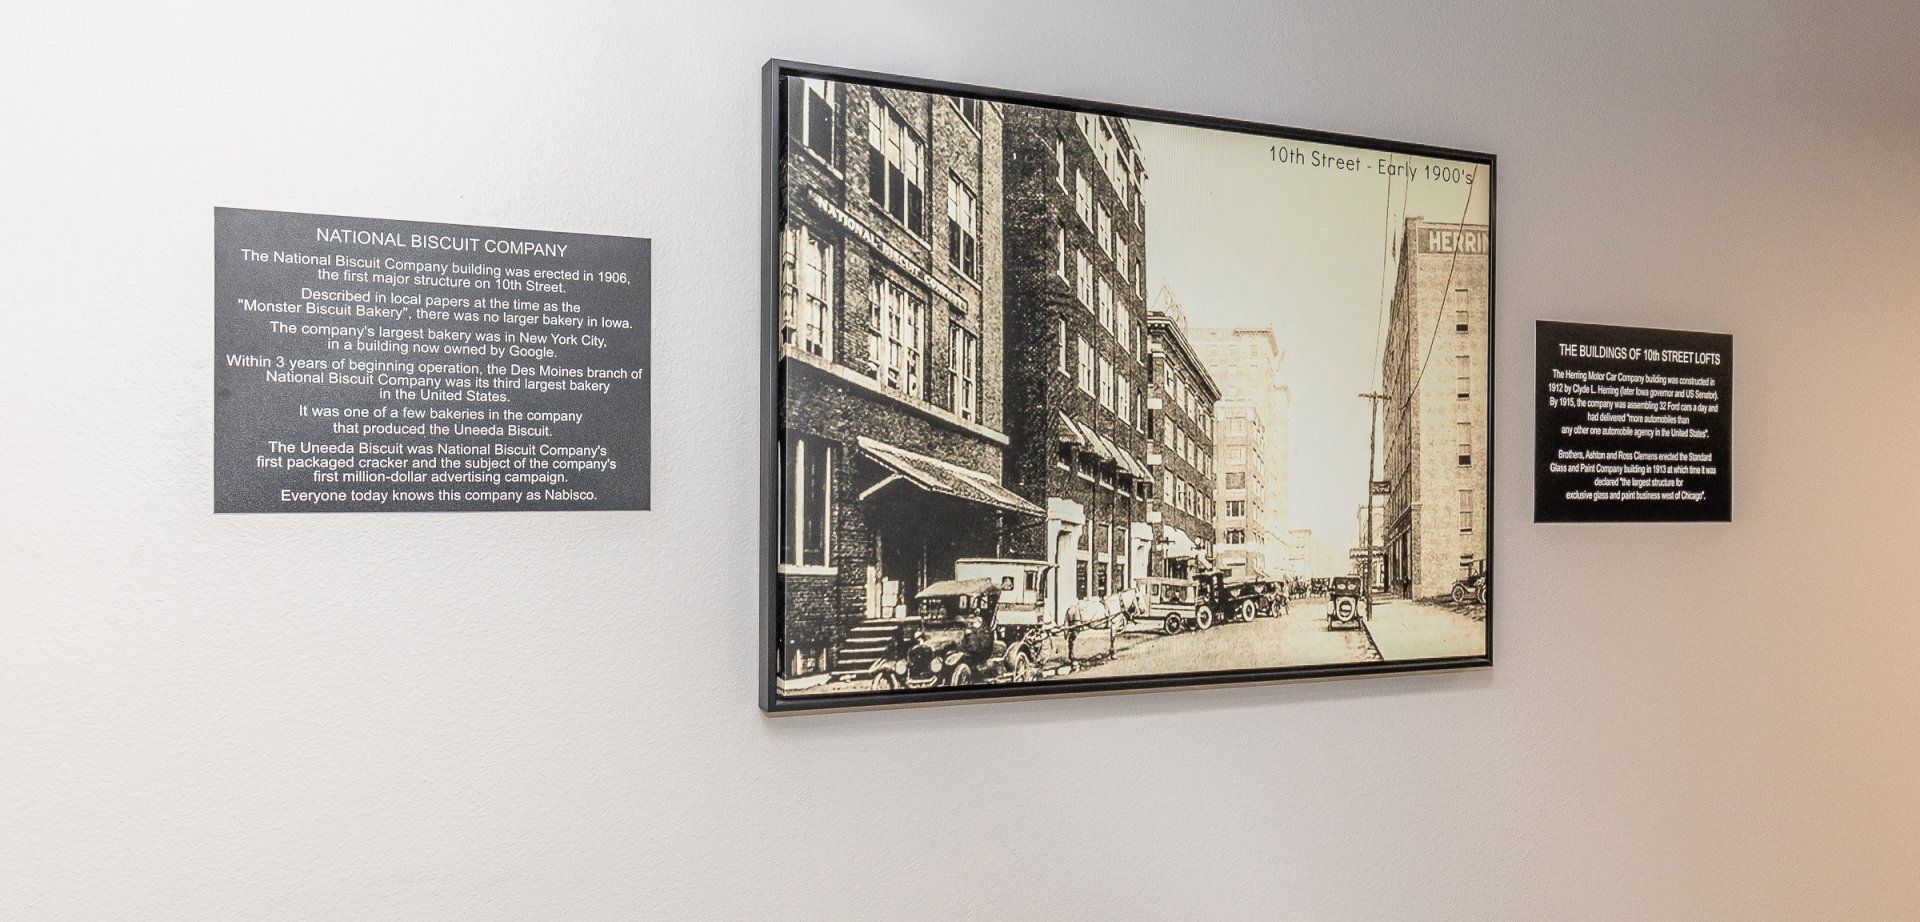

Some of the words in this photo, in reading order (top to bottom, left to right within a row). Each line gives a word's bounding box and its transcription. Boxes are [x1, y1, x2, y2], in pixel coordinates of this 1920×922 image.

[1270, 145, 1305, 165] 10th
[1311, 150, 1361, 171] Street
[1378, 158, 1417, 181] Early
[1425, 165, 1473, 185] 1900's
[817, 195, 877, 248] NATIONAL
[315, 227, 406, 247] NATIONAL
[411, 234, 479, 251] BISCUIT
[484, 239, 568, 257] COMPANY
[241, 249, 269, 262] The
[273, 251, 331, 266] National
[335, 255, 380, 269] Biscuit
[384, 258, 448, 276] Company
[452, 262, 501, 280] building
[504, 268, 530, 278] was
[533, 267, 579, 281] erected
[583, 270, 593, 282] in
[598, 271, 631, 286] 1906,
[316, 268, 339, 281] the
[343, 269, 368, 283] first
[372, 271, 410, 288] major
[413, 274, 470, 288] structure
[474, 280, 490, 289] on
[495, 278, 521, 291] 10th
[526, 280, 566, 294] Street.
[300, 287, 370, 302] Described
[374, 291, 386, 303] in
[390, 292, 421, 305] local
[425, 296, 470, 311] papers
[474, 297, 486, 308] at
[489, 297, 509, 310] the
[513, 298, 539, 311] time
[543, 303, 558, 312] as
[561, 301, 581, 313] the
[237, 298, 302, 314] "Monster
[305, 302, 351, 316] Biscuit
[356, 304, 411, 322] Bakery",
[416, 307, 449, 320] there
[453, 312, 479, 322] was
[483, 313, 499, 323] no
[503, 312, 539, 328] larger
[542, 313, 583, 330] bakery
[587, 316, 597, 327] in
[601, 316, 633, 329] Iowa.
[269, 321, 297, 334] The
[301, 323, 375, 341] company's
[379, 326, 423, 343] largest
[427, 328, 471, 345] bakery
[474, 333, 500, 343] was
[505, 332, 515, 343] in
[519, 332, 547, 345] New
[551, 334, 577, 346] York
[581, 335, 607, 350] City,
[326, 338, 339, 350] in
[343, 342, 352, 351] a
[356, 339, 408, 356] building
[412, 344, 440, 354] now
[443, 343, 486, 356] owned
[490, 345, 505, 360] by
[509, 345, 557, 362] Google.
[1558, 342, 1577, 356] THE
[1579, 344, 1627, 358] BUILDINGS
[1628, 347, 1641, 359] OF
[1643, 348, 1660, 360] 10th
[1661, 349, 1694, 363] STREET
[1694, 351, 1720, 364] LOFTS
[1552, 368, 1564, 378] The
[1565, 369, 1587, 381] Herring
[1587, 370, 1605, 380] Motor
[1605, 371, 1617, 380] Car
[1617, 372, 1644, 384] Company
[1645, 373, 1666, 386] building
[1679, 375, 1709, 385] constructed
[1709, 377, 1715, 386] in
[1548, 382, 1563, 391] 1912
[1563, 383, 1571, 394] by
[1572, 383, 1590, 395] Clyde
[1597, 384, 1619, 396] Herring
[1635, 386, 1649, 395] Iowa
[1649, 389, 1674, 399] governor
[1674, 388, 1685, 397] and
[1685, 389, 1694, 398] US
[1549, 396, 1558, 408] By
[1576, 397, 1586, 406] the
[1587, 400, 1613, 410] company
[1626, 399, 1658, 412] assembling
[1659, 401, 1666, 410] 32
[1667, 401, 1680, 410] Ford
[1697, 402, 1707, 414] day
[1707, 403, 1718, 412] and
[332, 421, 359, 433] that
[363, 422, 425, 438] produced
[429, 423, 449, 435] the
[454, 423, 503, 436] Uneeda
[508, 424, 552, 436] Biscuit.
[267, 440, 295, 452] The
[300, 440, 354, 453] Uneeda
[359, 441, 403, 453] Biscuit
[406, 445, 433, 454] was
[437, 442, 490, 454] National
[494, 443, 535, 455] Biscuit
[539, 444, 607, 458] Company's
[1584, 450, 1605, 459] Ashton
[1605, 450, 1617, 459] and
[1617, 450, 1633, 459] Ross
[1633, 451, 1658, 460] Clemens
[1658, 451, 1678, 460] erected
[1679, 452, 1688, 460] the
[1688, 452, 1712, 461] Standard
[256, 454, 282, 467] first
[287, 455, 354, 470] packaged
[358, 455, 408, 468] cracker
[412, 456, 436, 468] and
[440, 456, 461, 468] the
[465, 456, 510, 471] subject
[513, 457, 526, 468] of
[529, 457, 548, 468] the
[552, 457, 616, 472] company's
[312, 470, 338, 482] first
[342, 470, 427, 482] million-dollar
[431, 470, 500, 485] advertising
[504, 471, 568, 485] campaign.
[280, 489, 346, 505] Everyone
[351, 489, 388, 504] today
[392, 489, 434, 501] knows
[438, 489, 460, 501] this
[464, 492, 522, 504] company
[526, 492, 541, 501] as
[545, 489, 597, 501] Nabisco.
[1565, 490, 1592, 498] exclusive
[1593, 490, 1608, 501] glass
[1609, 490, 1620, 499] and
[1621, 490, 1635, 501] paint
[1635, 490, 1660, 499] business
[1660, 491, 1674, 499] west
[1674, 491, 1680, 499] of
